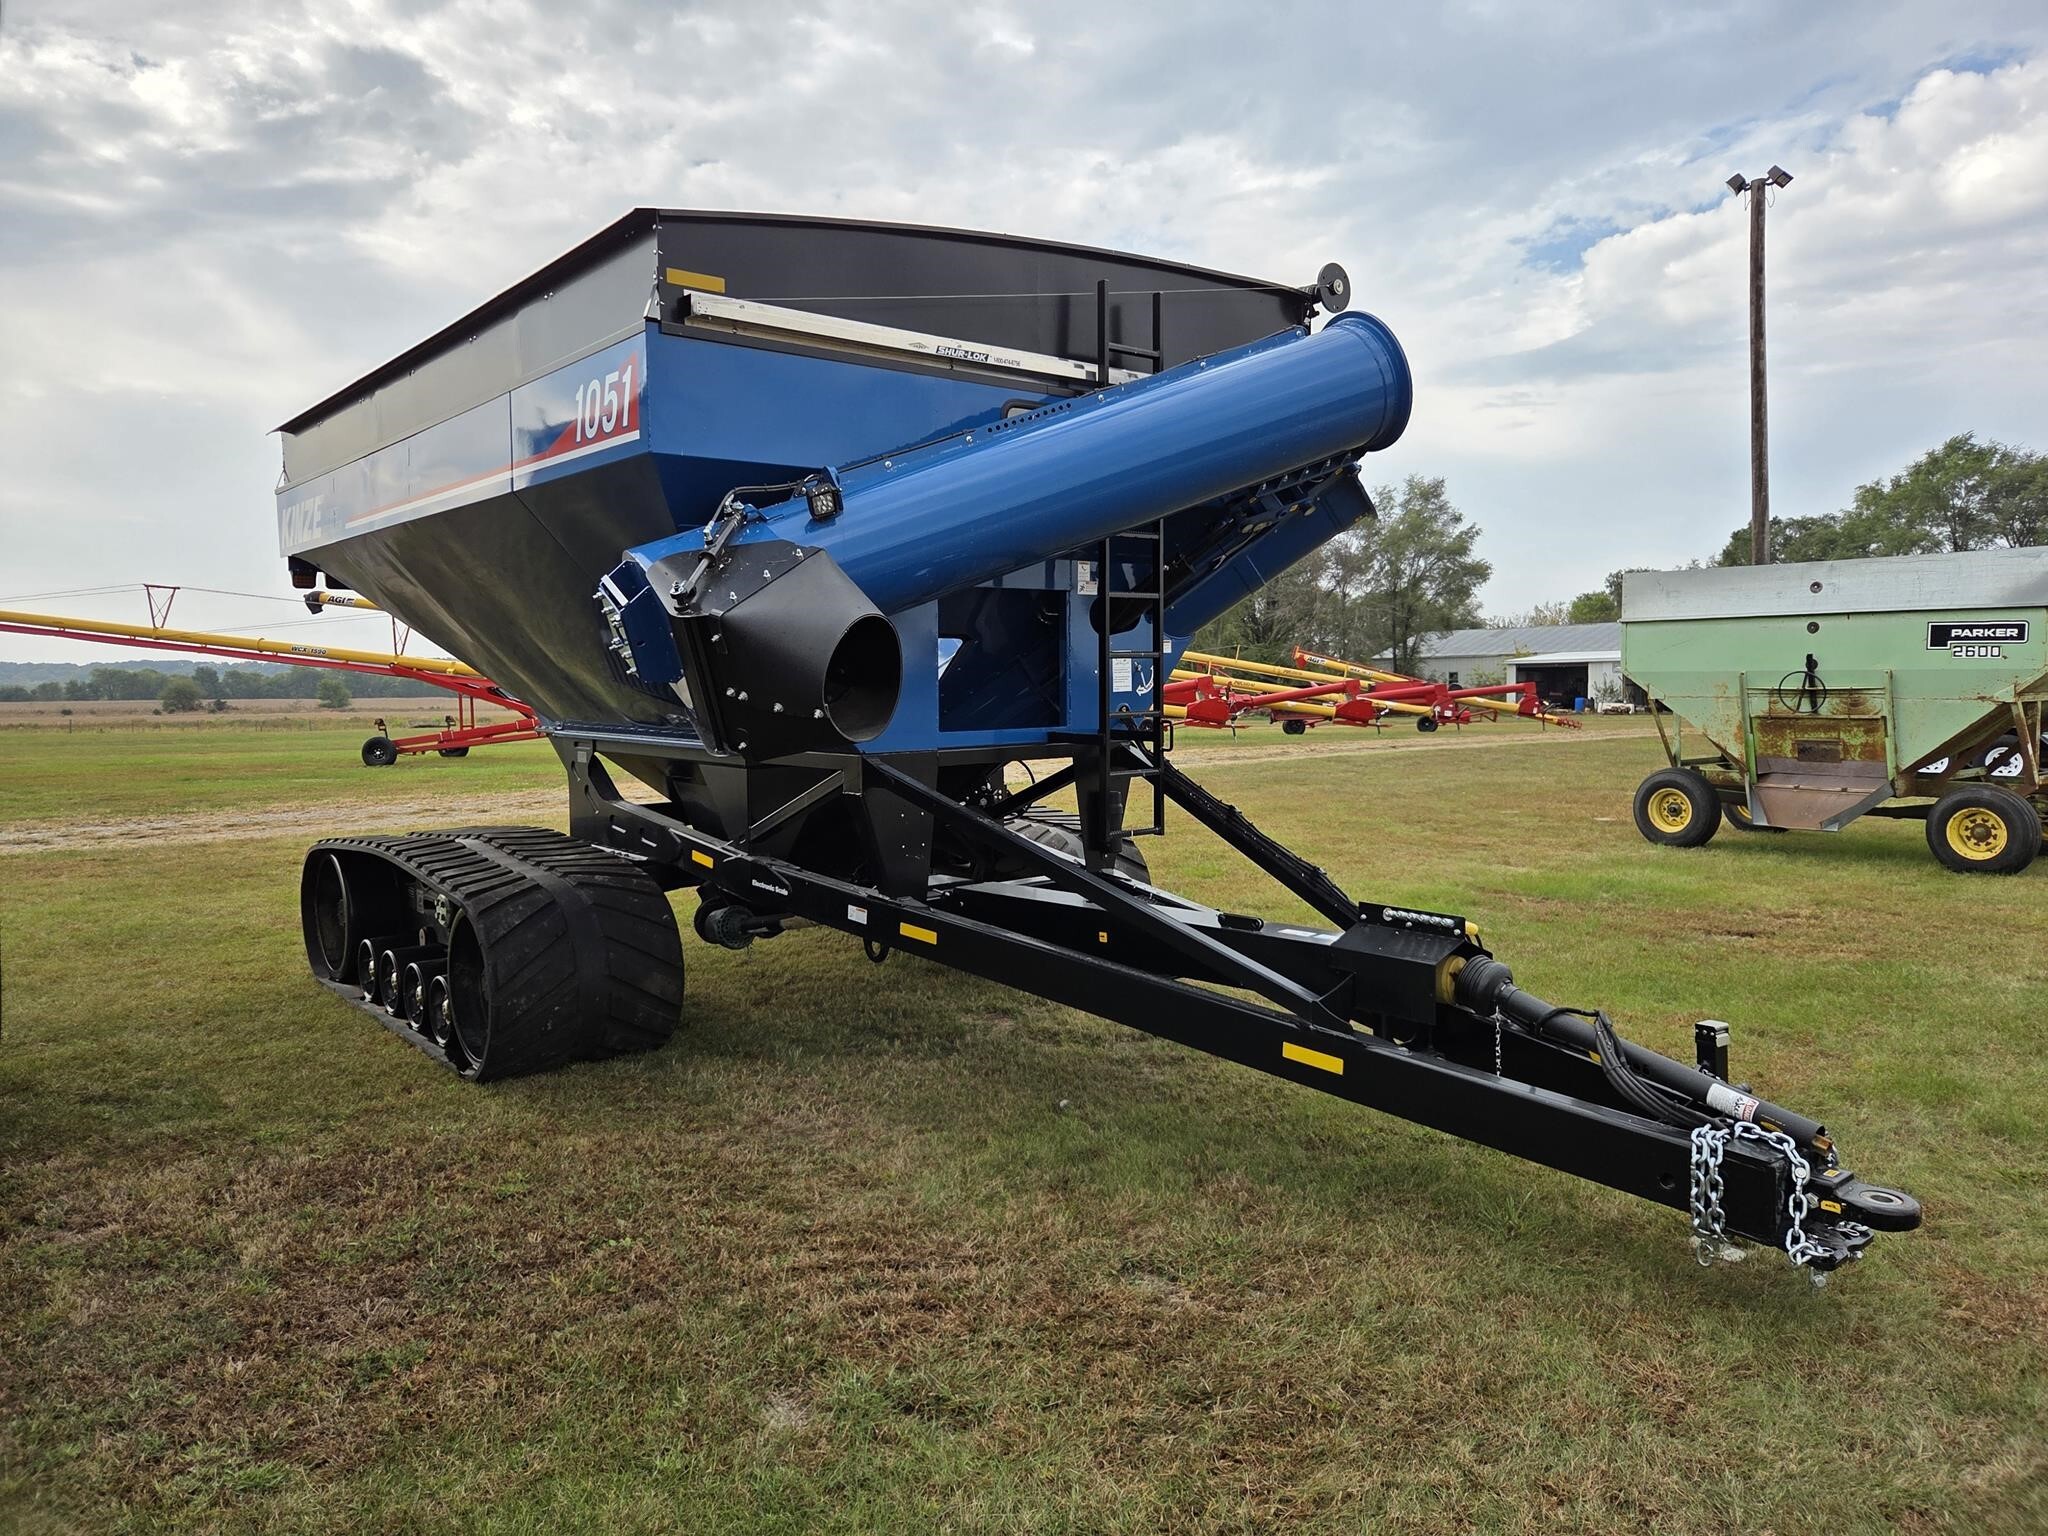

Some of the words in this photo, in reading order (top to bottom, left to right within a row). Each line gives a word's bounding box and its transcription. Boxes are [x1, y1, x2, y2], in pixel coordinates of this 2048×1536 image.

[576, 365, 632, 442] 1051
[282, 494, 325, 549] KINZE
[327, 595, 346, 604] AGI
[1951, 628, 2019, 637] PARKER
[1953, 645, 2001, 657] 2600
